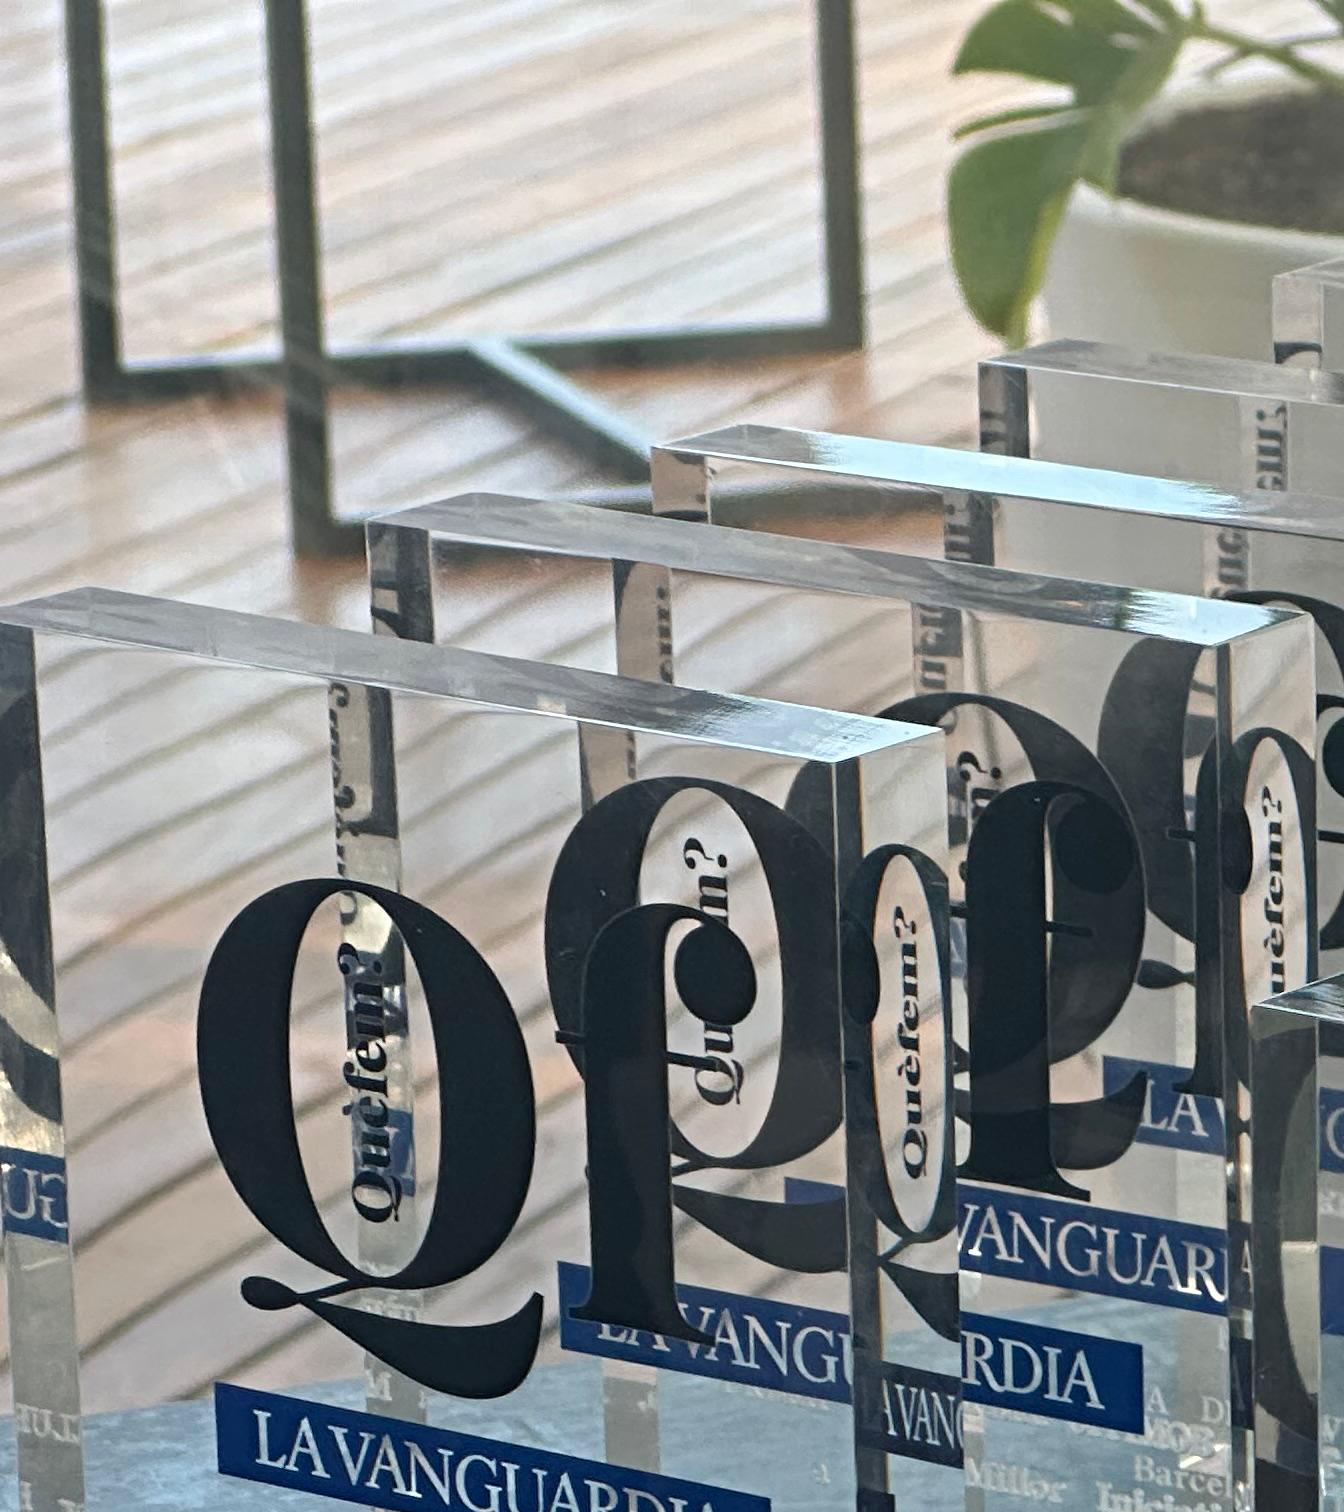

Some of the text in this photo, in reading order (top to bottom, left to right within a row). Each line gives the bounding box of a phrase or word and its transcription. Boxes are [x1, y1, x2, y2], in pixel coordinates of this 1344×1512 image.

[338, 939, 402, 1225] Quèfem?
[682, 836, 742, 1106] Qum?
[892, 906, 930, 1179] Quèfem?
